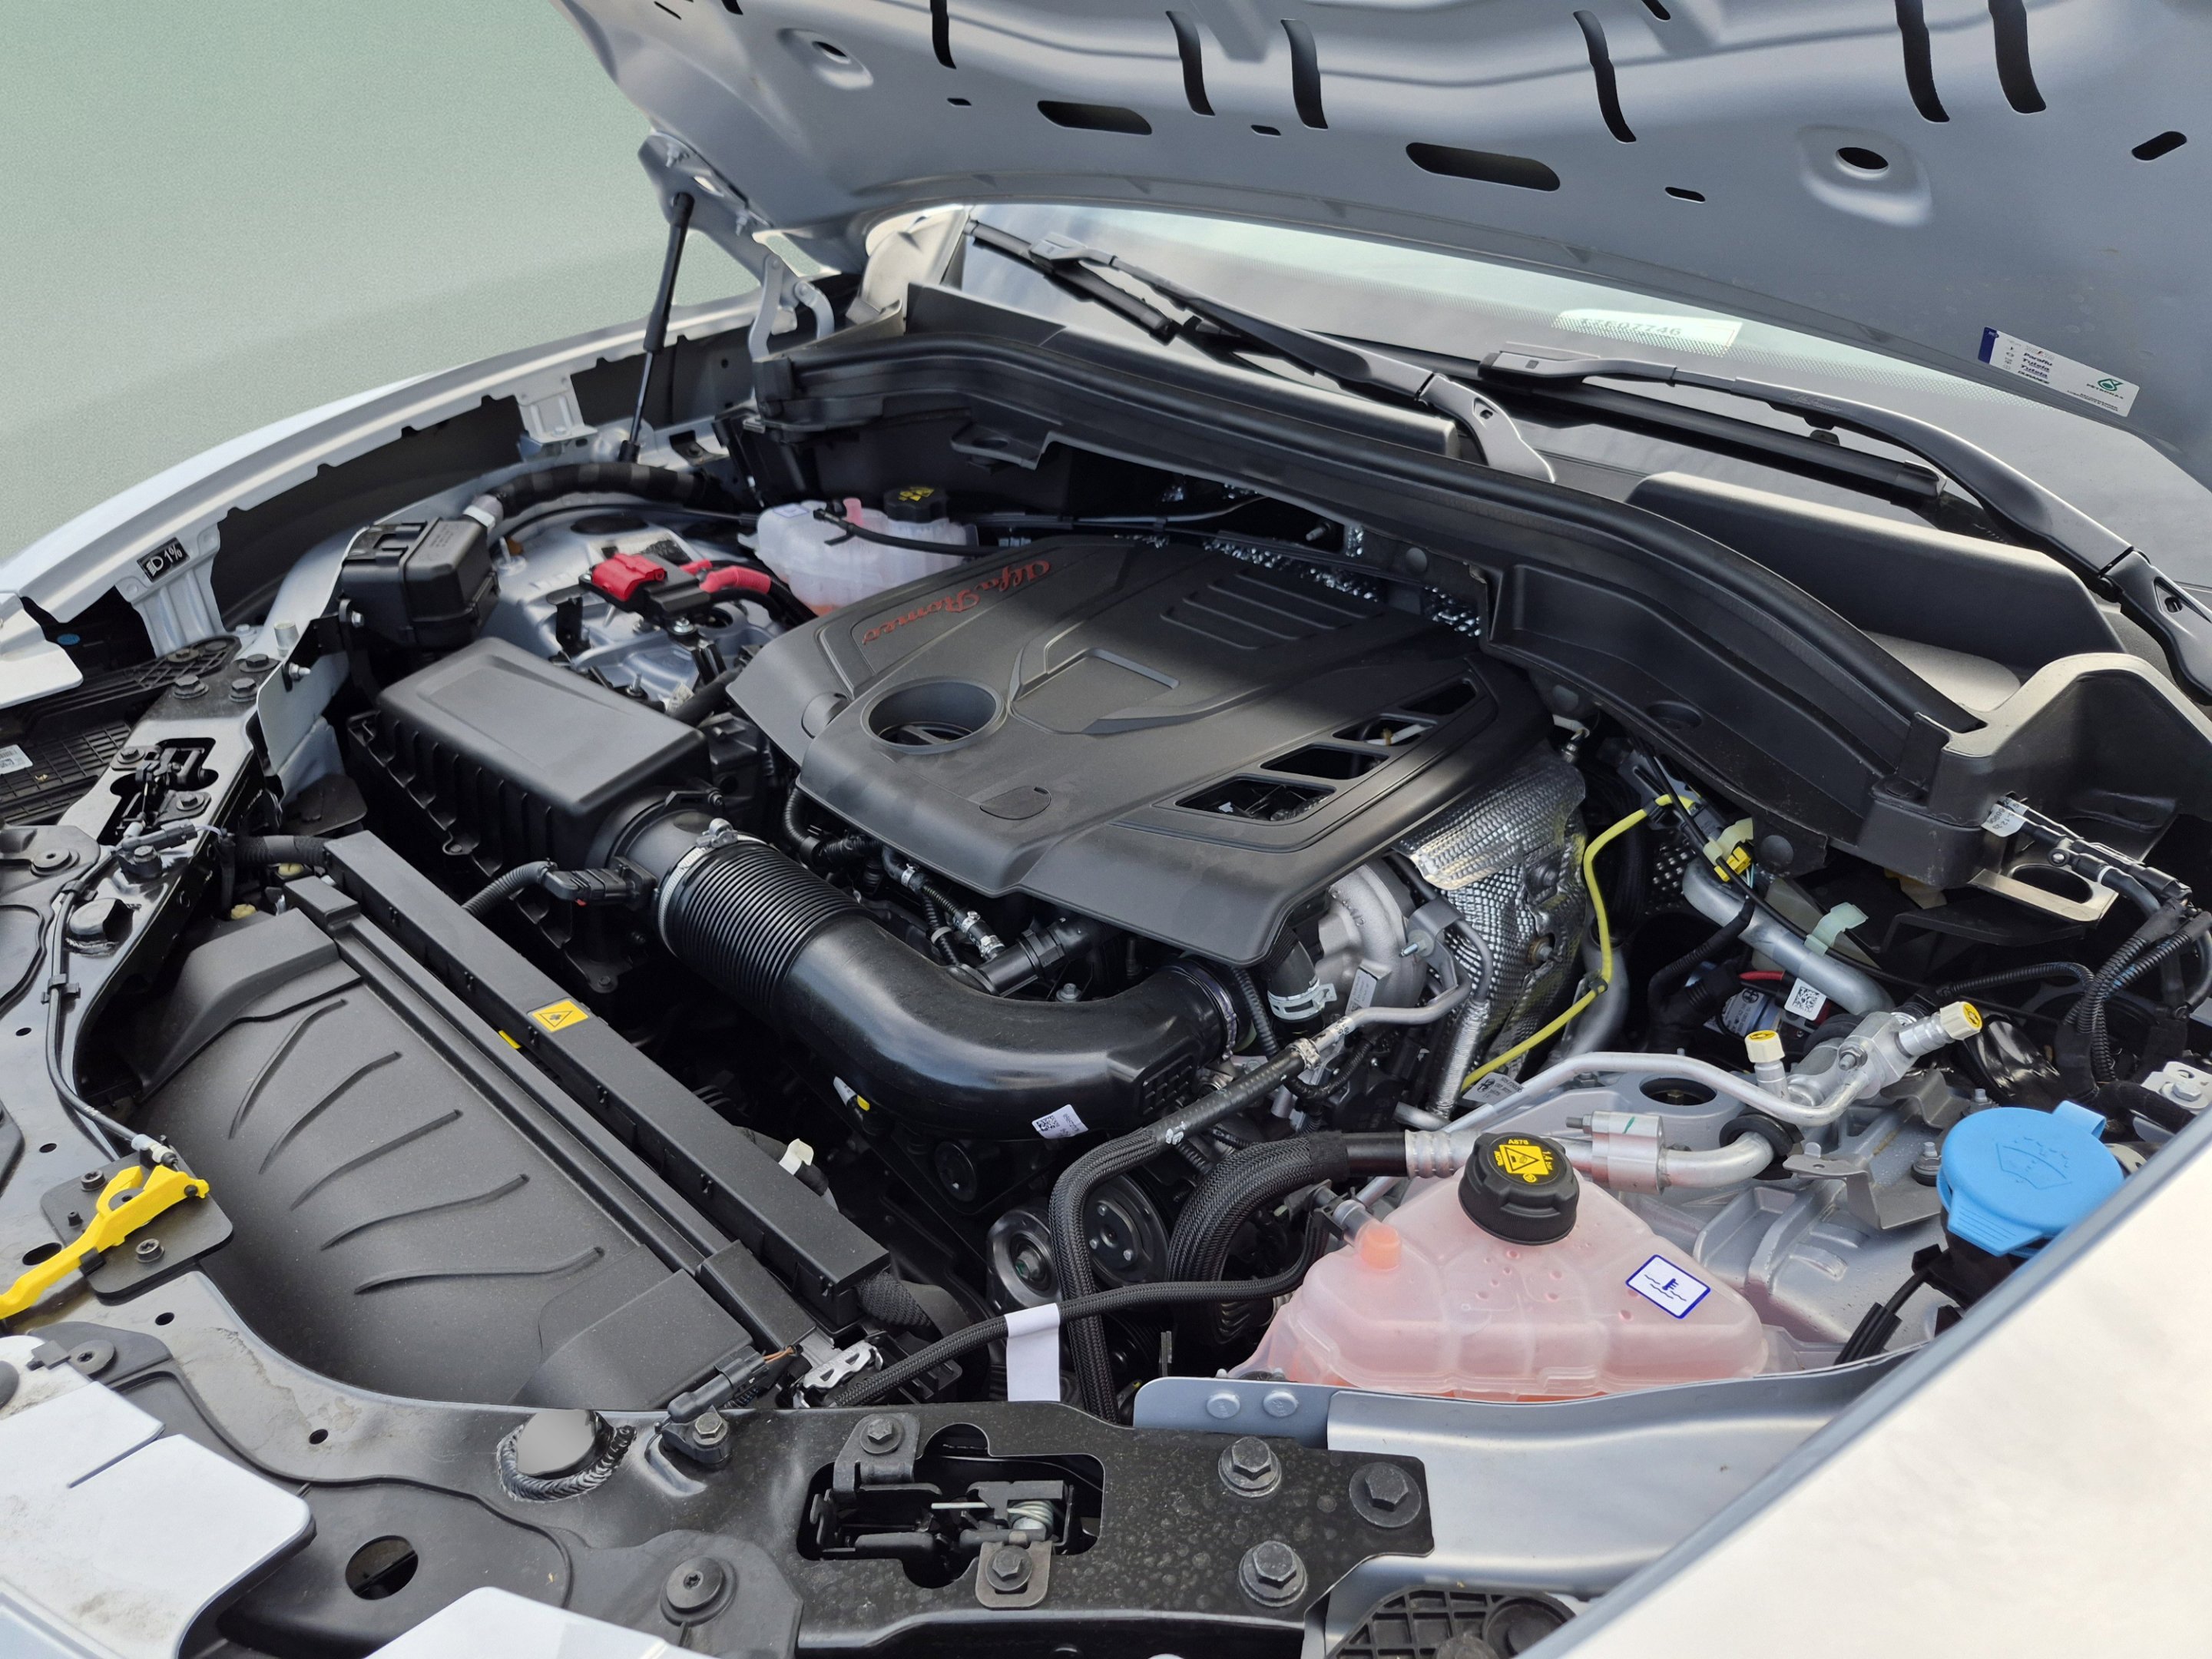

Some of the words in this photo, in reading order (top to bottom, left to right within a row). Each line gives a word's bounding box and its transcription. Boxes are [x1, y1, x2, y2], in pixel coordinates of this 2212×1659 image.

[2020, 363, 2048, 378] Tutela
[2022, 357, 2050, 371] Tutela
[2086, 382, 2124, 399] PETRONAS
[977, 560, 1051, 592] Alfa
[862, 589, 981, 645] Romeo
